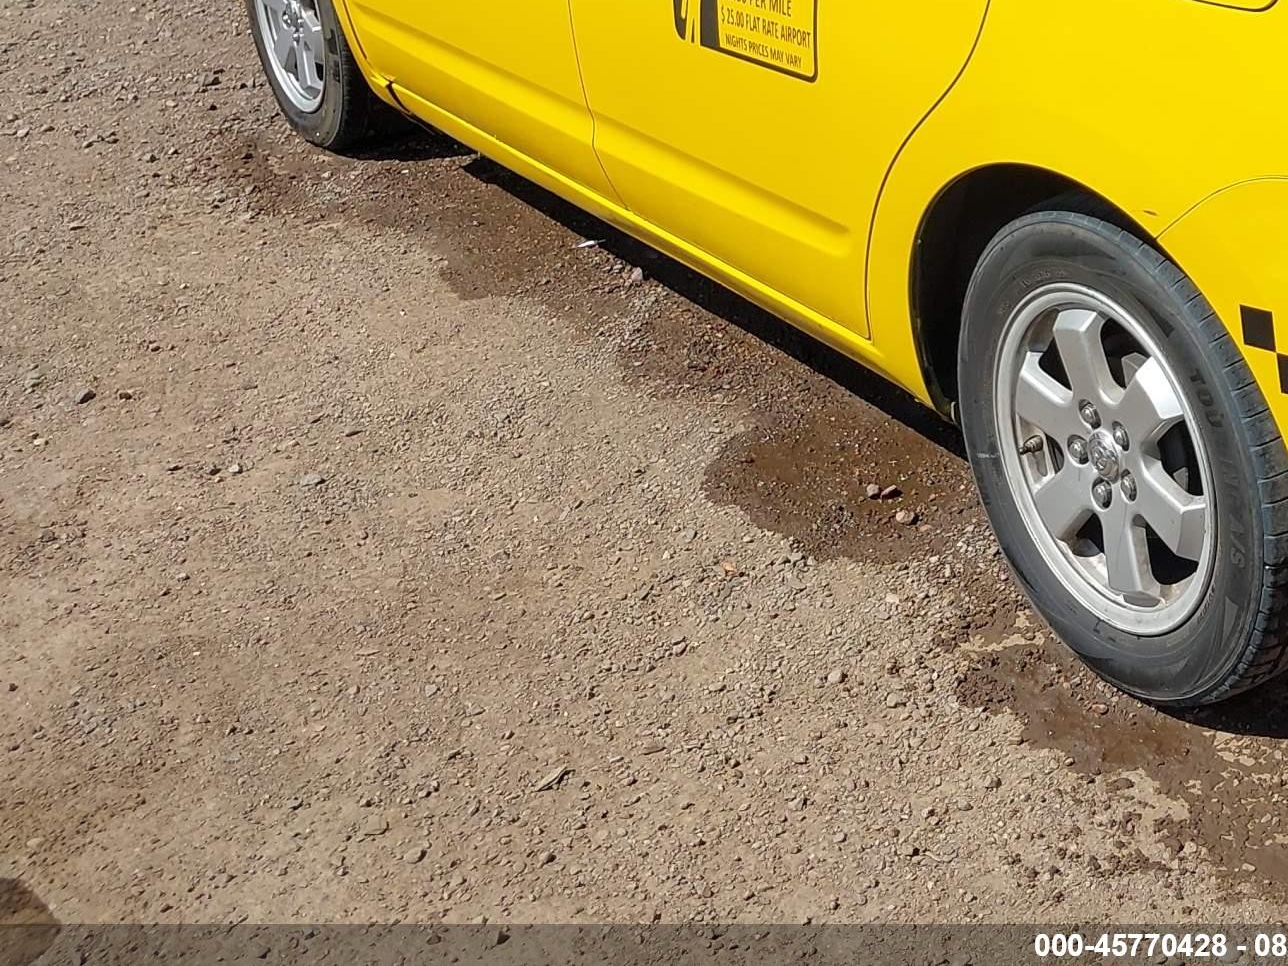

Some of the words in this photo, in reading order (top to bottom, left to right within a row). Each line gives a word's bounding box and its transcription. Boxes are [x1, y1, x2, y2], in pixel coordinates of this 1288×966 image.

[746, 15, 761, 33] FLAT
[762, 18, 779, 40] RATE
[780, 24, 812, 50] AIRPORT
[725, 33, 748, 51] NIGHTS
[749, 40, 769, 58] PRICES
[770, 47, 785, 63] MAY
[785, 52, 802, 69] VARY
